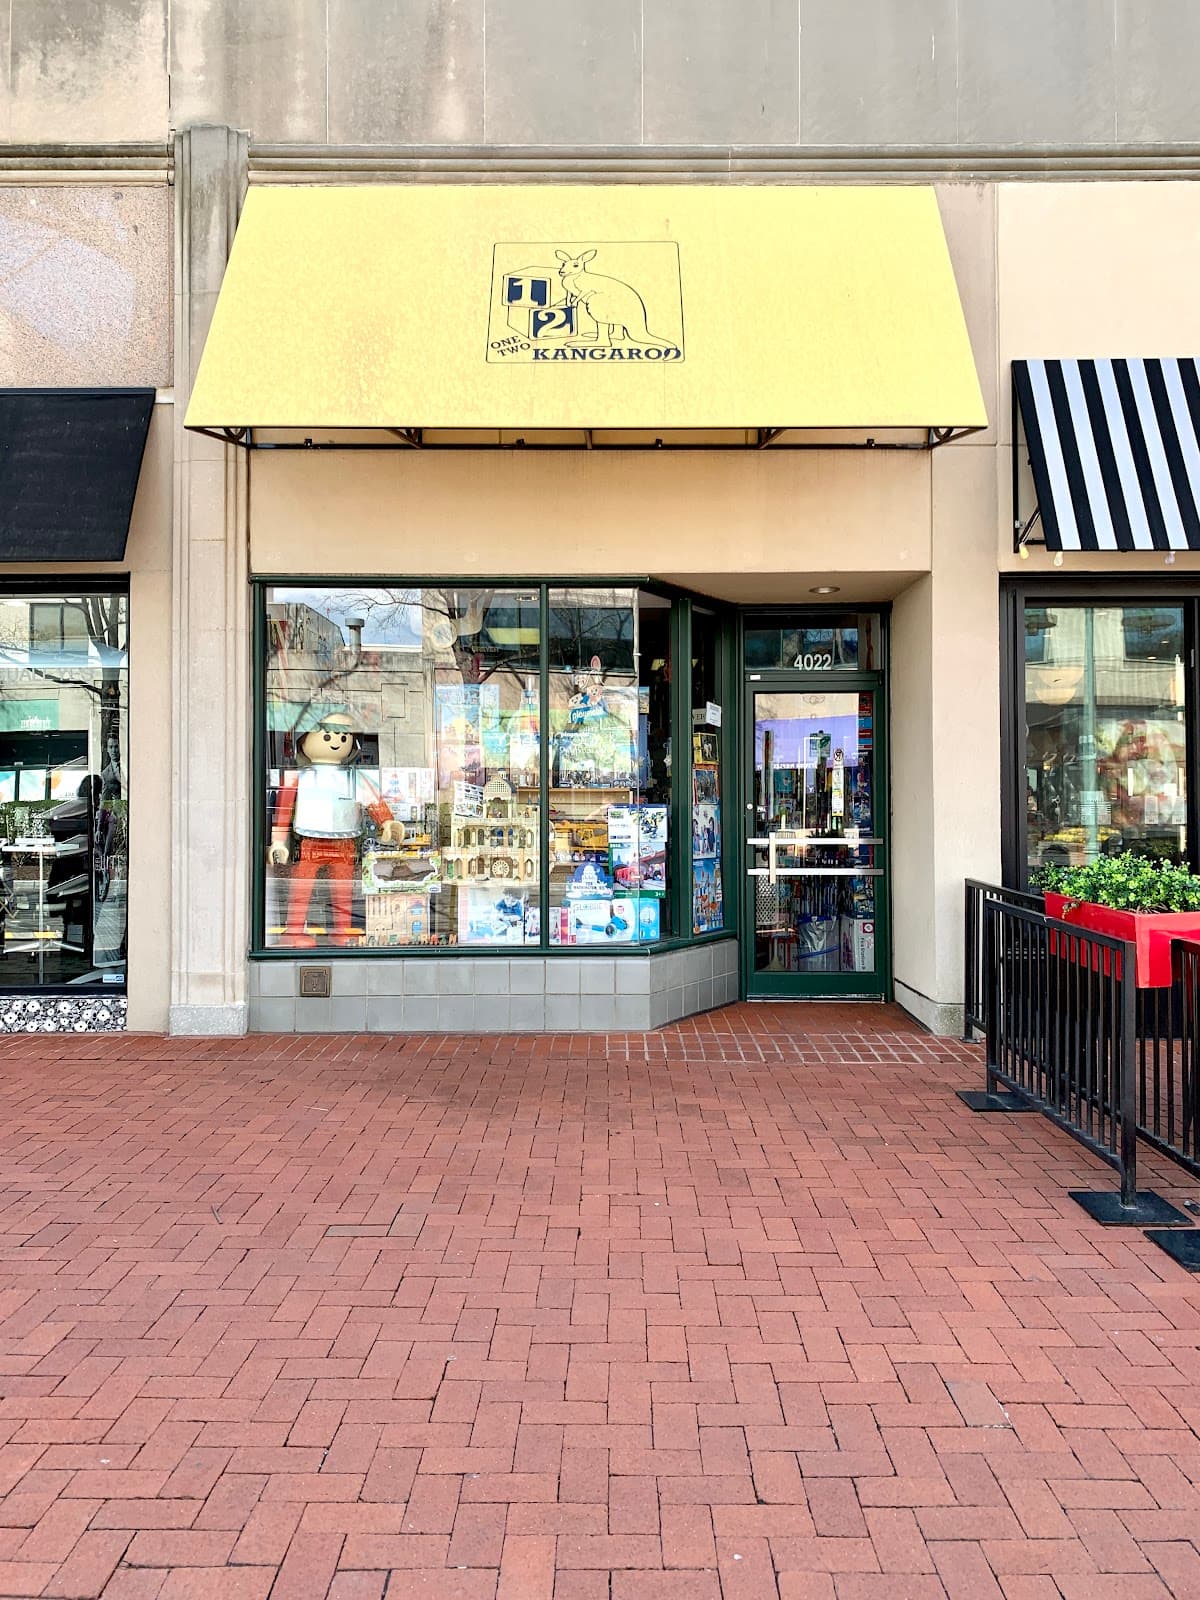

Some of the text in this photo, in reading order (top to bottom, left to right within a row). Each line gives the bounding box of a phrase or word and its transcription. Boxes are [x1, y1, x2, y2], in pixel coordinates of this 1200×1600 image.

[510, 277, 541, 306] 1
[534, 308, 574, 338] 2
[490, 335, 520, 350] ONE
[497, 342, 531, 357] TWO
[532, 348, 681, 361] KANGAROO
[793, 653, 832, 671] 4022
